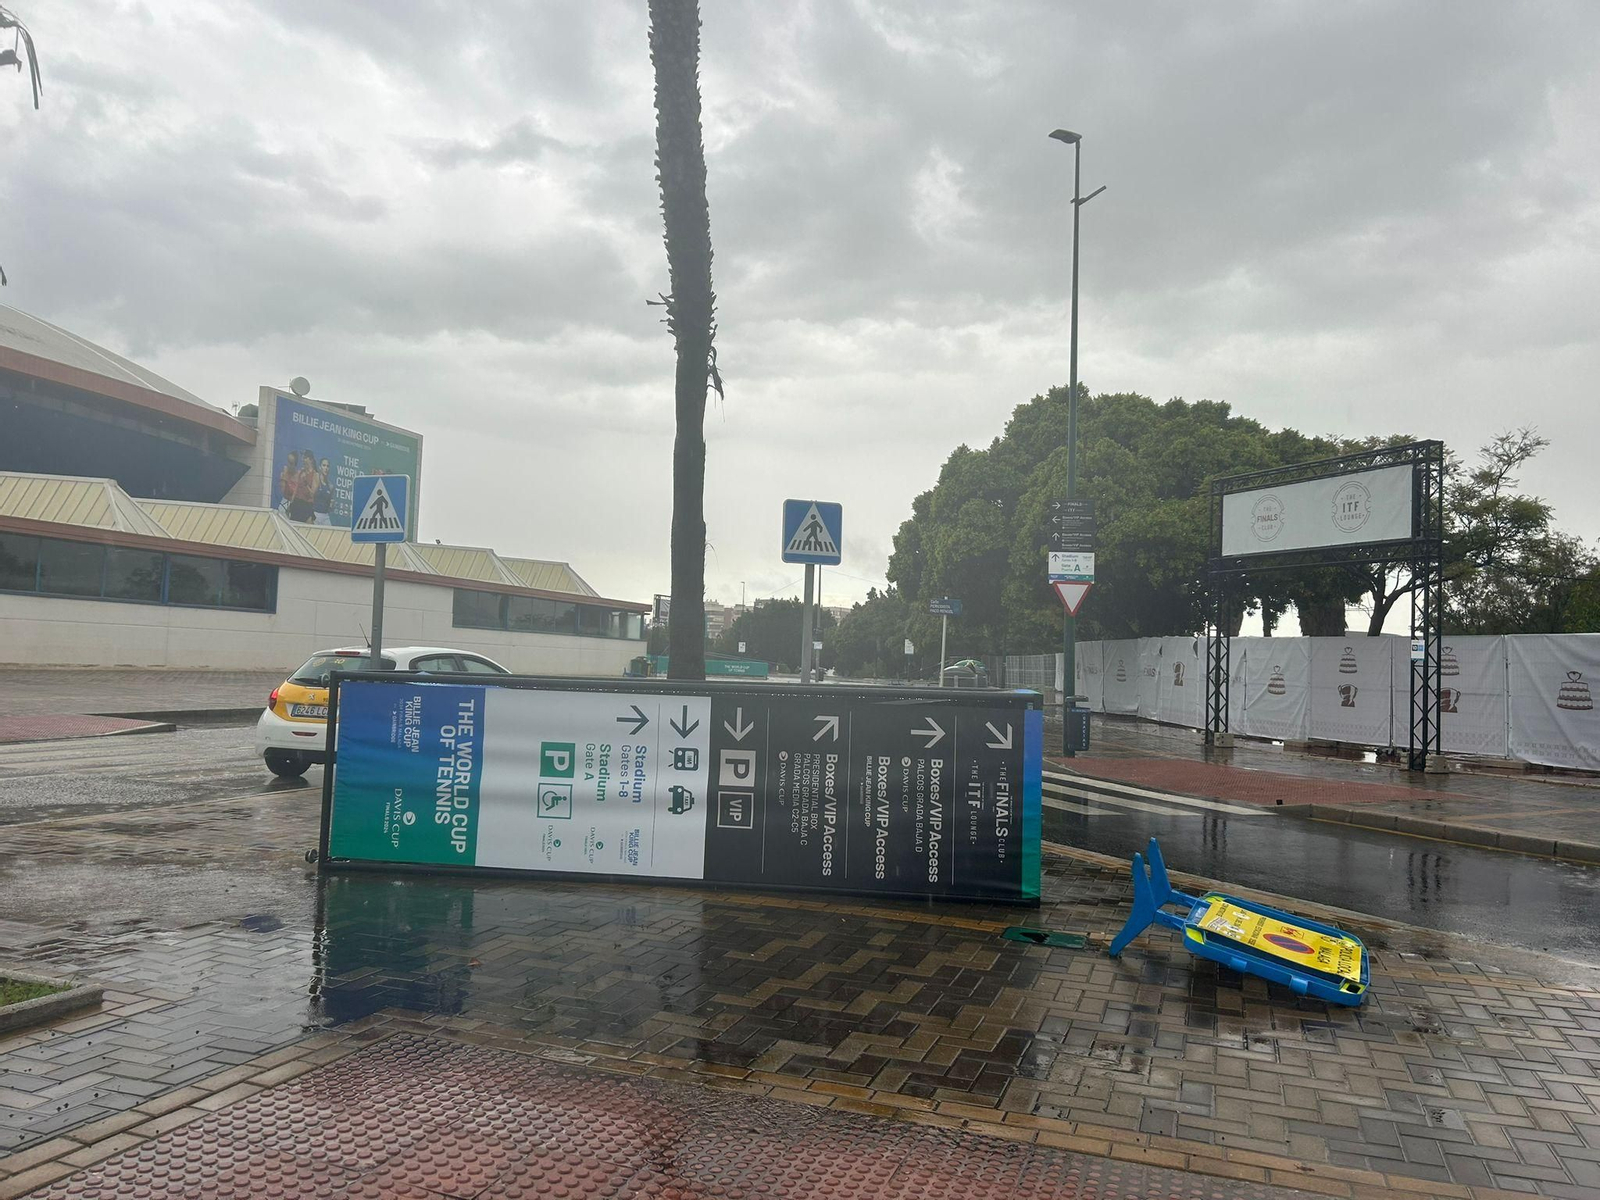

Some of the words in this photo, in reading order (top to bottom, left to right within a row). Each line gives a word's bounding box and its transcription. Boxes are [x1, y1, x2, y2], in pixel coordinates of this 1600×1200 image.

[292, 412, 319, 429] BILLIE
[319, 421, 342, 435] JEAN
[342, 427, 363, 441] KING
[363, 433, 379, 445] CUP
[343, 455, 360, 468] THE
[335, 488, 353, 500] TEN
[336, 478, 352, 489] CUP
[1257, 514, 1278, 522] FINALS
[1340, 513, 1362, 521] LOUNGE
[1342, 501, 1359, 512] ITF
[297, 706, 315, 715] 6246
[405, 701, 413, 725] KING
[412, 696, 421, 725] BILLIE
[458, 699, 474, 737] THE
[403, 728, 411, 747] CUP
[411, 727, 419, 753] JEAN
[440, 725, 456, 749] OF
[545, 750, 570, 771] P
[585, 743, 596, 769] Gate
[620, 745, 631, 777] Gates
[725, 758, 750, 779] P
[792, 753, 801, 780] GRADA
[802, 753, 811, 785] PALCOS
[865, 756, 873, 776] BILLIE
[453, 741, 473, 809] WORLD
[584, 772, 594, 781] A
[597, 744, 611, 801] Stadium
[632, 745, 647, 803] Stadium
[811, 754, 820, 811] PRESIDENTIAL
[902, 768, 910, 793] DAVIS
[915, 759, 924, 791] PALCOS
[971, 765, 979, 779] THE
[999, 766, 1007, 781] THE
[435, 755, 454, 824] TENNIS
[618, 780, 630, 798] 1-8
[792, 782, 800, 807] MEDIA
[801, 787, 810, 814] GRADA
[824, 754, 838, 824] Boxes/VIP
[876, 756, 891, 827] Boxes/VIP
[929, 759, 944, 830] Boxes/VIP
[968, 782, 981, 809] ITF
[392, 788, 402, 821] DAVIS
[729, 799, 742, 822] VIP
[864, 795, 872, 812] KING
[915, 792, 924, 821] GRADA
[994, 782, 1009, 837] FINALS
[450, 814, 468, 853] CUP
[791, 808, 799, 833] C2-C5
[800, 816, 808, 838] BAJA
[810, 813, 818, 830] BOX
[915, 822, 923, 844] BAJA
[969, 811, 978, 840] LOUNGE
[391, 824, 400, 848] CUP
[822, 825, 835, 876] Access
[875, 828, 889, 879] Access
[928, 831, 942, 883] Access
